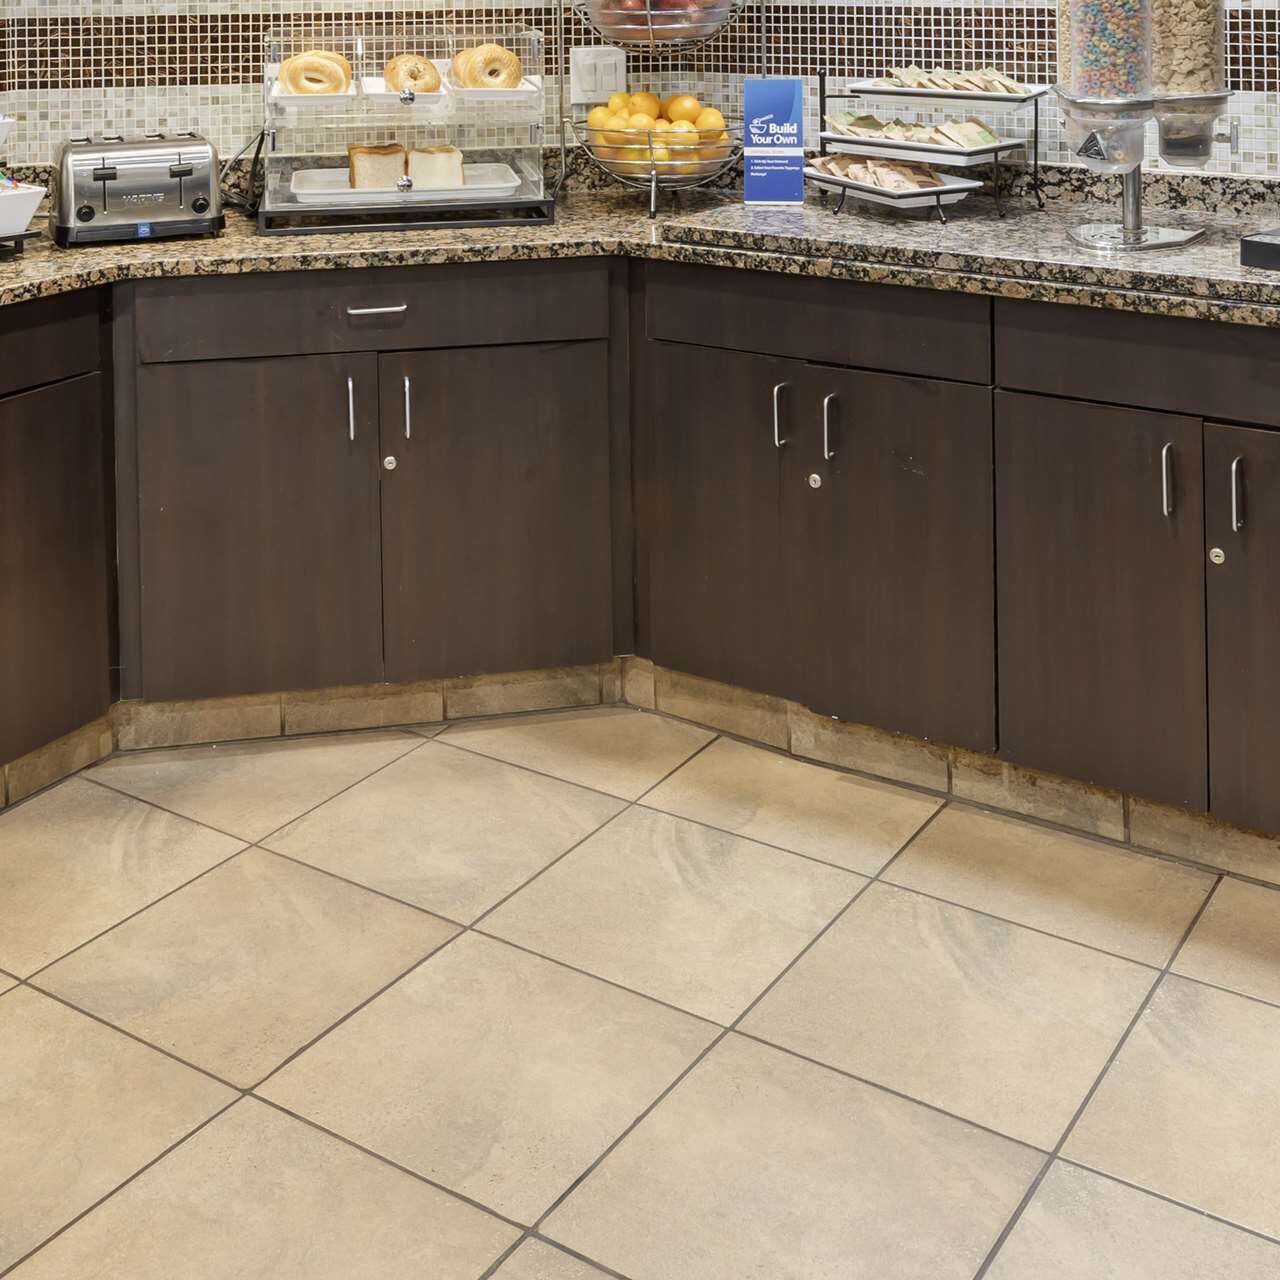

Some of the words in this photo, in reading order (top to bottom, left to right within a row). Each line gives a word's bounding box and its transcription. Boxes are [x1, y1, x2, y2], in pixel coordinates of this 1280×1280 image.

[769, 123, 798, 134] Build
[750, 134, 773, 144] Your
[774, 134, 798, 144] Own
